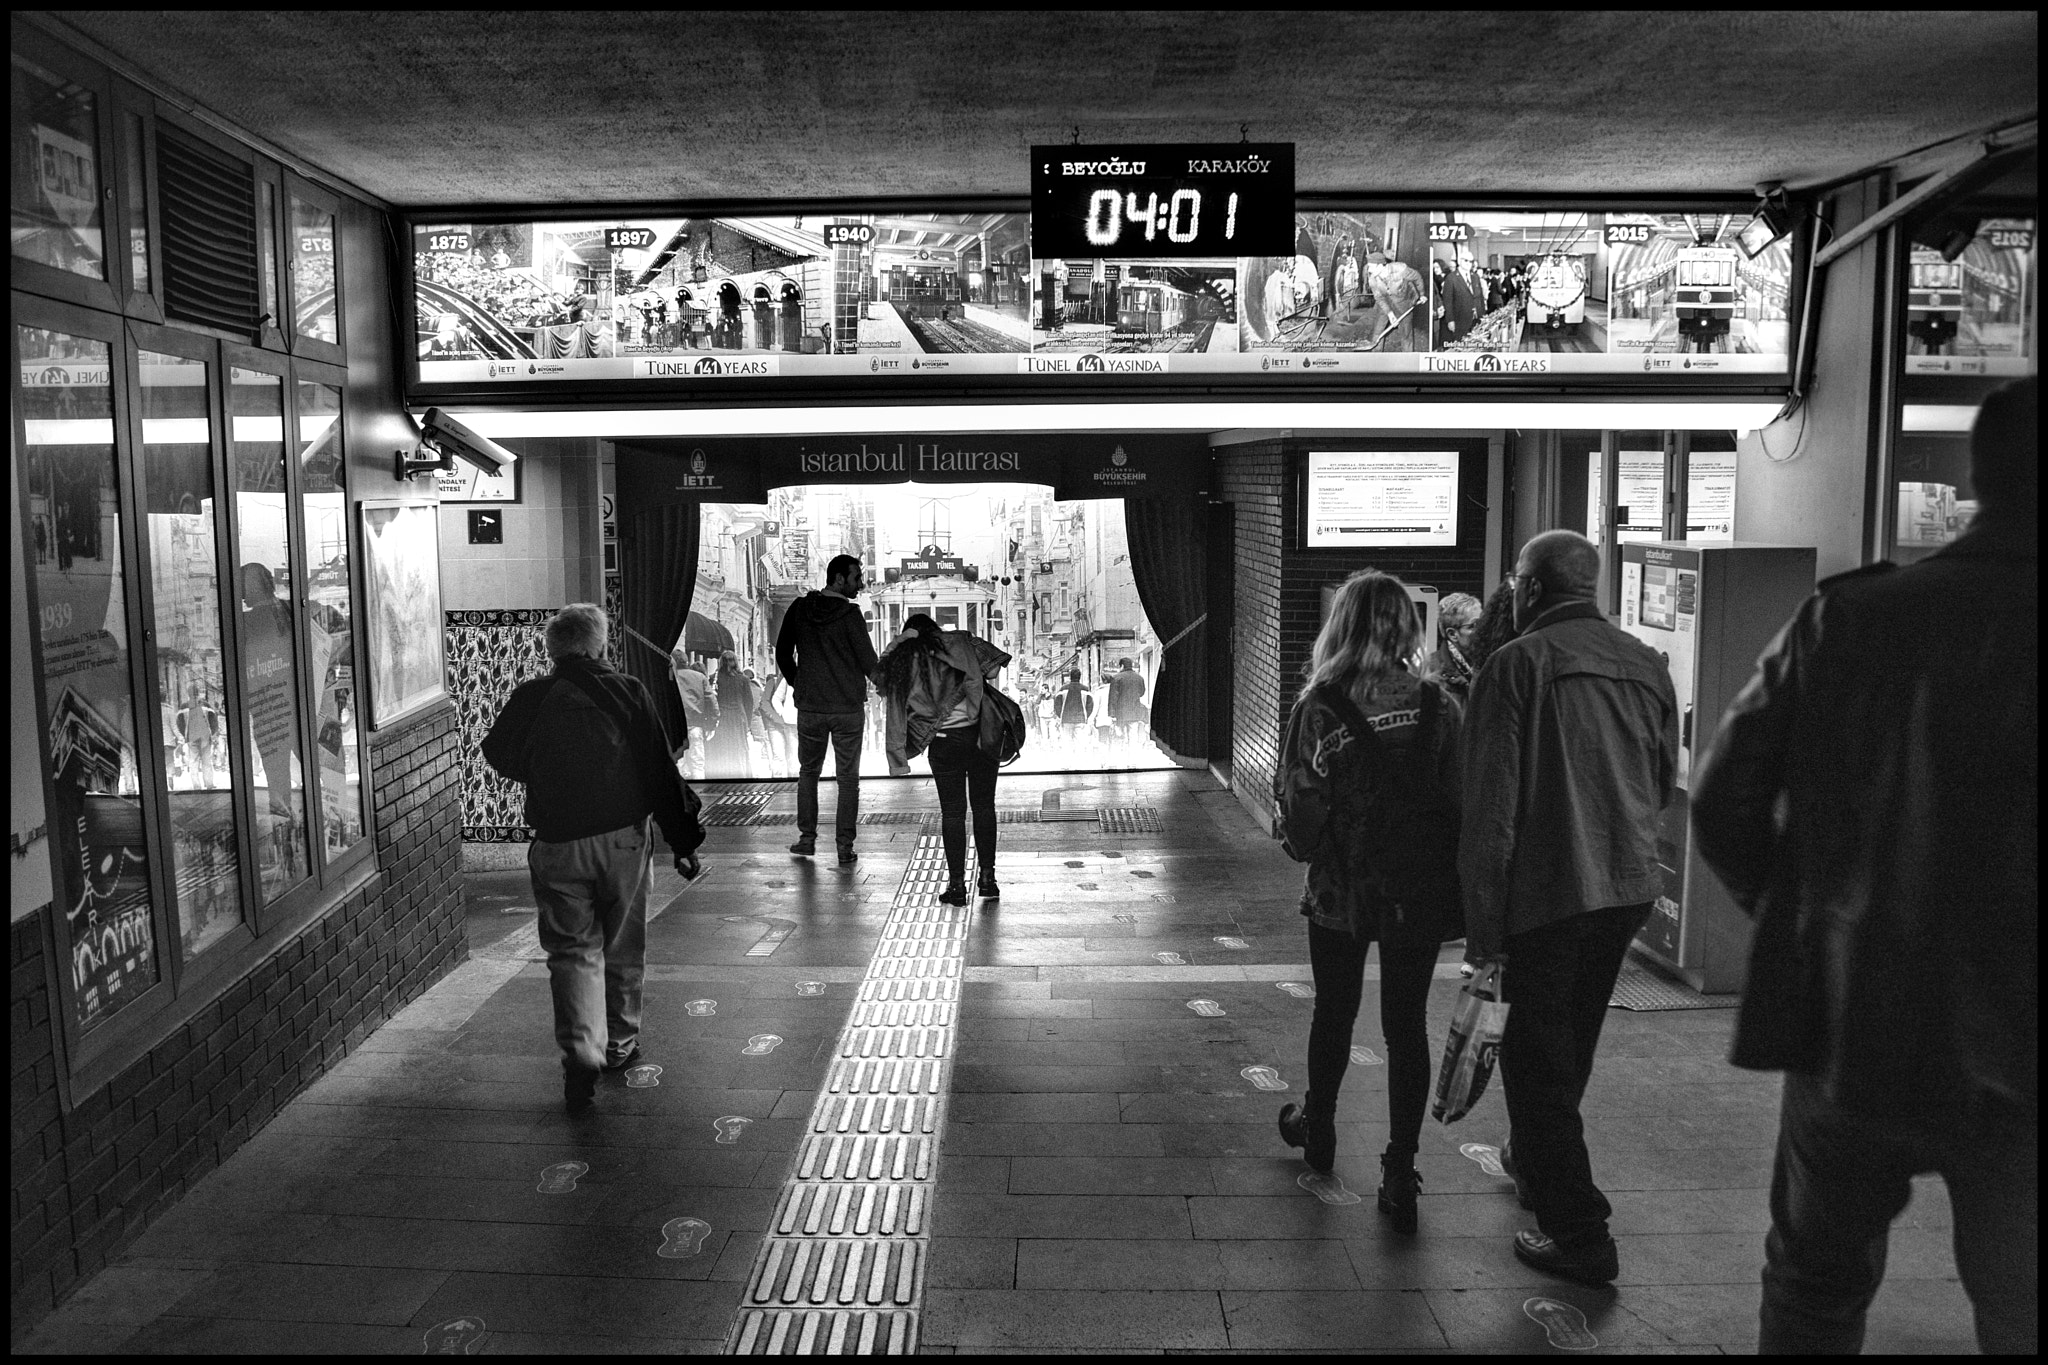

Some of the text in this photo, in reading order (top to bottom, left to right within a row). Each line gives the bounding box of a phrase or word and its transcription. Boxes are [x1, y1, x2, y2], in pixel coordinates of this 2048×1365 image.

[1062, 155, 1271, 176] BEYOĞLU KARAKÖY
[1086, 189, 1238, 245] 04:01
[610, 231, 650, 246] 1897
[829, 228, 870, 242] 1940
[1429, 226, 1467, 240] 1971
[1608, 227, 1648, 241] 2015
[430, 235, 468, 250] 1875
[644, 360, 690, 375] TÜNEL
[724, 361, 768, 374] YEARS
[1023, 356, 1071, 372] TÜNEL
[1108, 359, 1163, 373] YAŞINDA
[1424, 356, 1470, 372] TÜNEL
[1503, 359, 1546, 372] YEARS
[800, 443, 1021, 472] istanbul Hatırası
[683, 473, 715, 486] İETT
[1093, 471, 1147, 481] BÜYÜKŞEHİR
[929, 546, 936, 556] 2
[906, 560, 956, 570] TAKSİM TÜNEL
